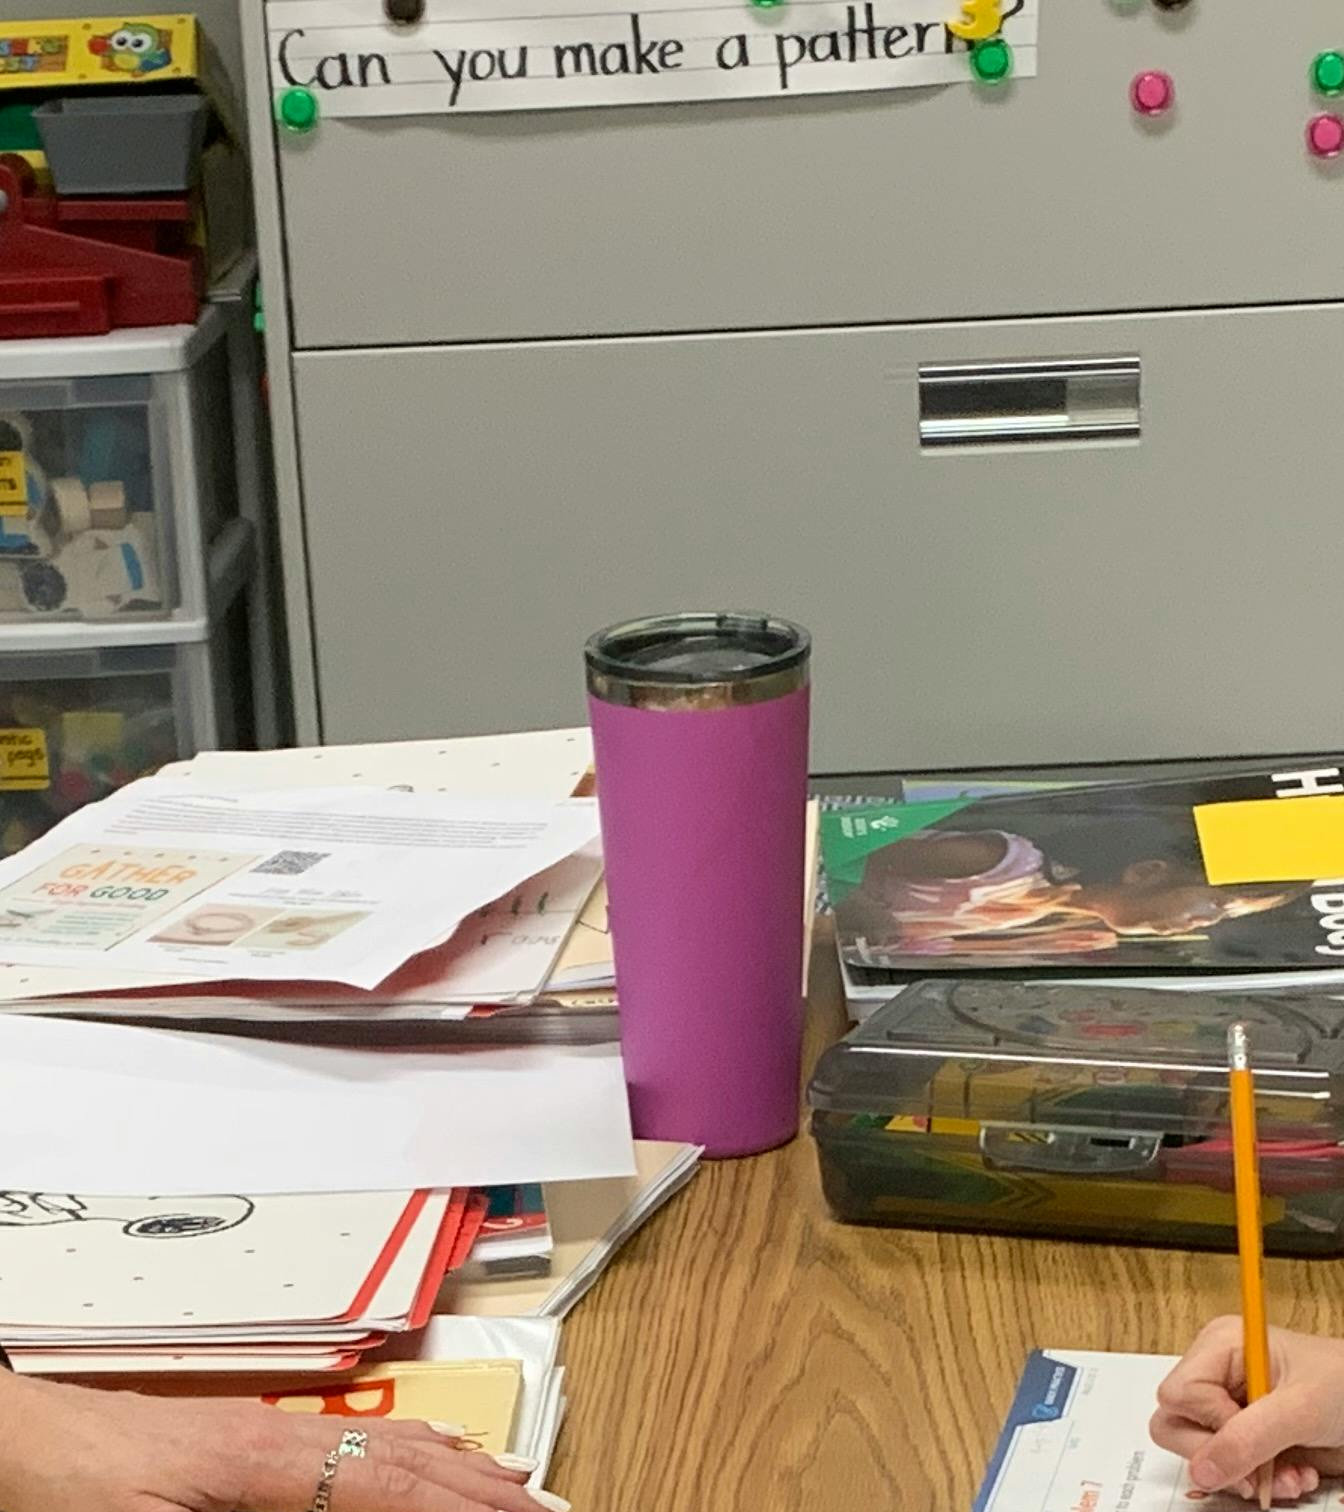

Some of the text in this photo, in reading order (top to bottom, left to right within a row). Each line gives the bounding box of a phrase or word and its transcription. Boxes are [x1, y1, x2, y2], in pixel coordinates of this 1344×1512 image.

[279, 28, 391, 90] Can
[433, 45, 528, 106] you
[556, 13, 685, 79] make
[716, 34, 750, 70] a
[59, 860, 198, 885] GATHER
[31, 883, 170, 902] FOR GOOD
